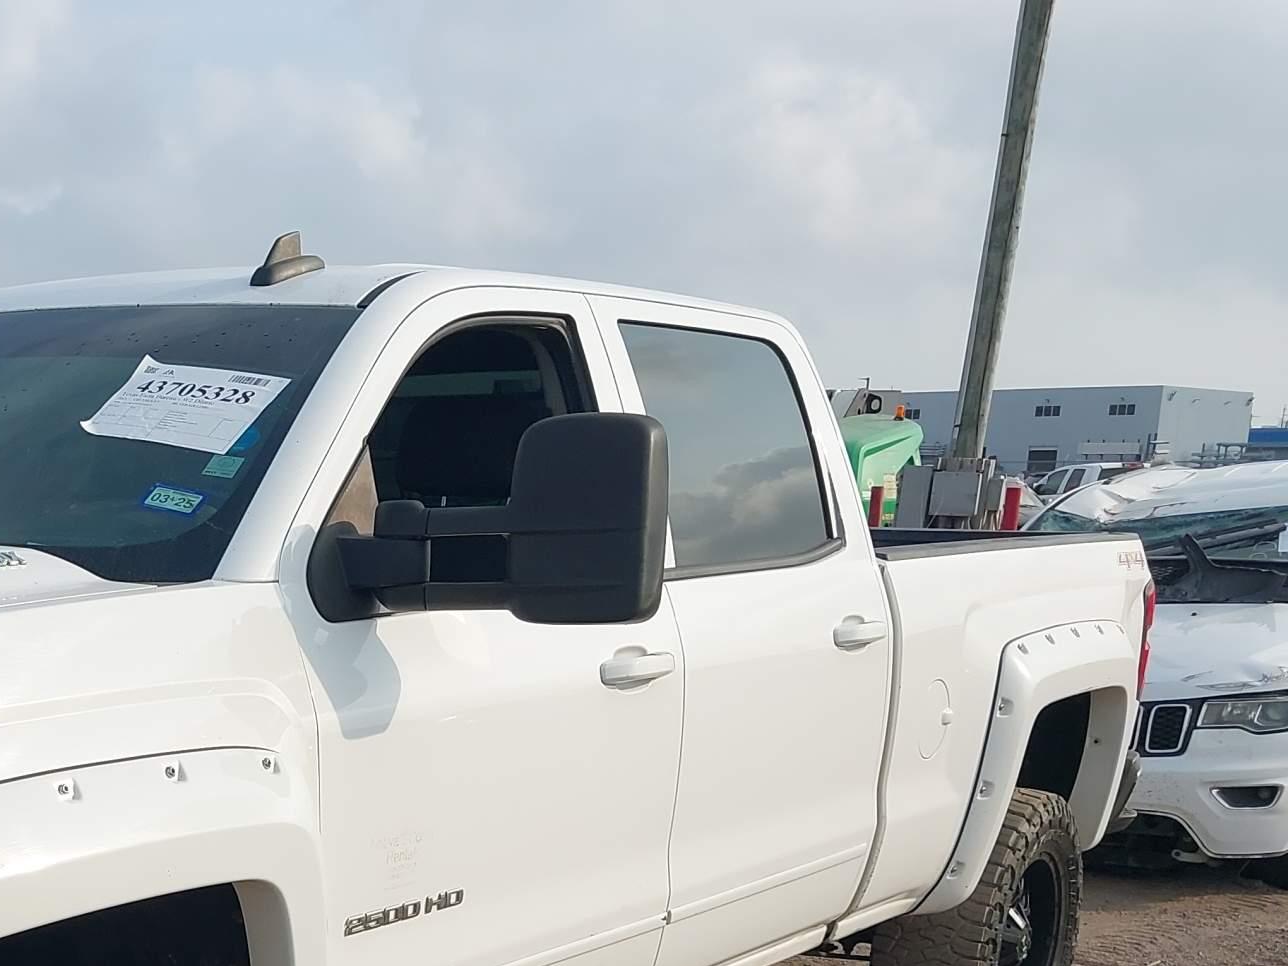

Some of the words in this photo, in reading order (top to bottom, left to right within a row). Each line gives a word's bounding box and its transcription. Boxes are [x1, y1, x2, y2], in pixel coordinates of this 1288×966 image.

[137, 379, 256, 405] 43705328
[343, 900, 421, 937] 2500
[424, 889, 464, 914] HD
